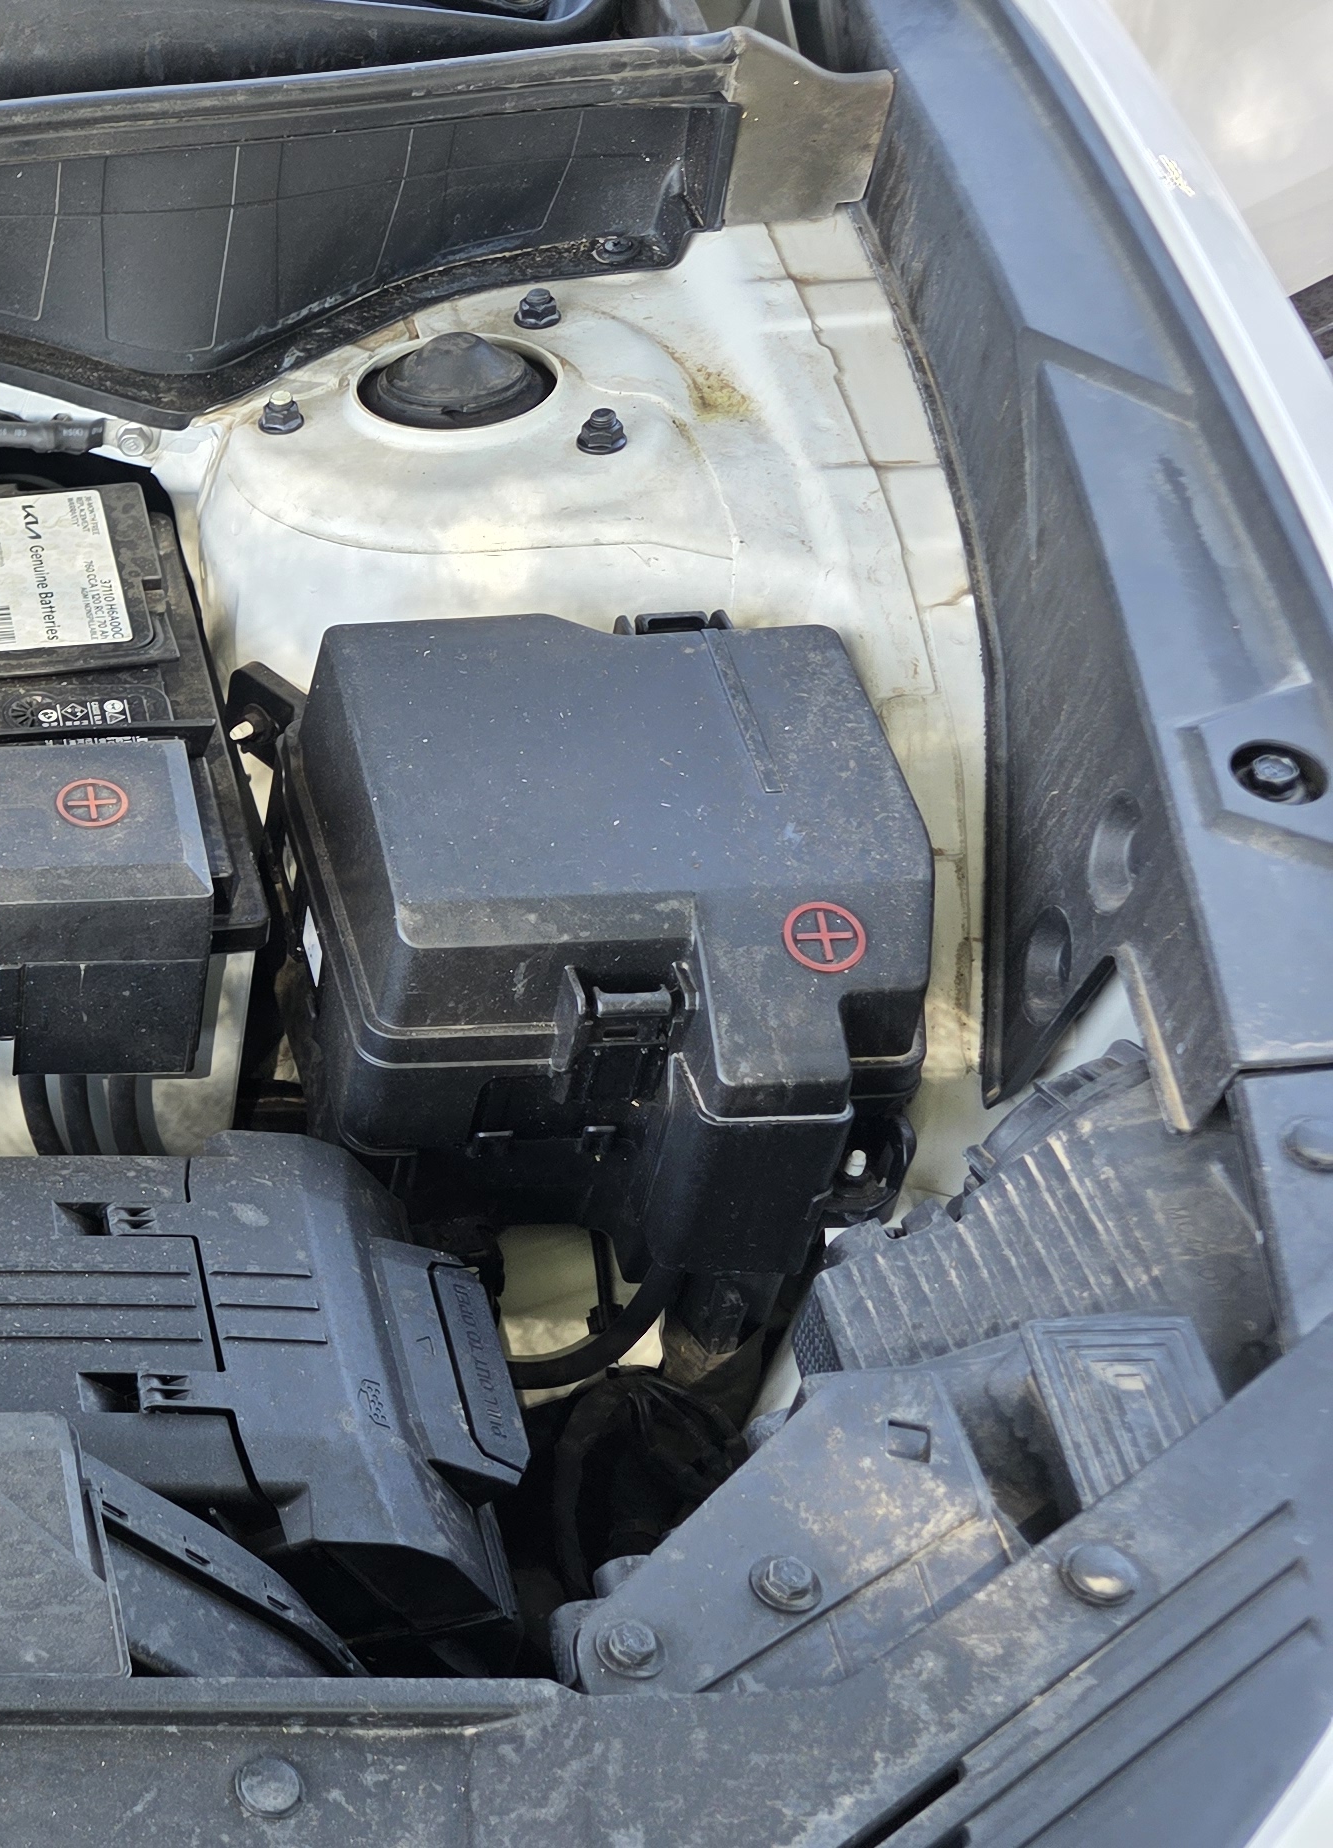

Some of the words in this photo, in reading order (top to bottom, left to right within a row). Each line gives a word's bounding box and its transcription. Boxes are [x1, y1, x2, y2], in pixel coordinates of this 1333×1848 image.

[21, 505, 42, 540] KIA
[76, 497, 90, 532] REPLACEMENT
[90, 522, 100, 536] FREE
[29, 545, 49, 589] Genuine
[83, 560, 96, 574] 760
[80, 587, 89, 599] AGM
[86, 574, 100, 588] CCA
[100, 580, 114, 602] 37110
[91, 593, 102, 604] 120
[38, 592, 60, 641] Batteries
[83, 603, 98, 640] NONSPILLABLE
[93, 606, 104, 616] RC
[105, 603, 123, 639] H6A00C
[96, 620, 107, 628] 70
[98, 630, 108, 639] Ah
[453, 1283, 477, 1328] OPEN
[466, 1331, 485, 1358] TO
[476, 1359, 495, 1392] OUT
